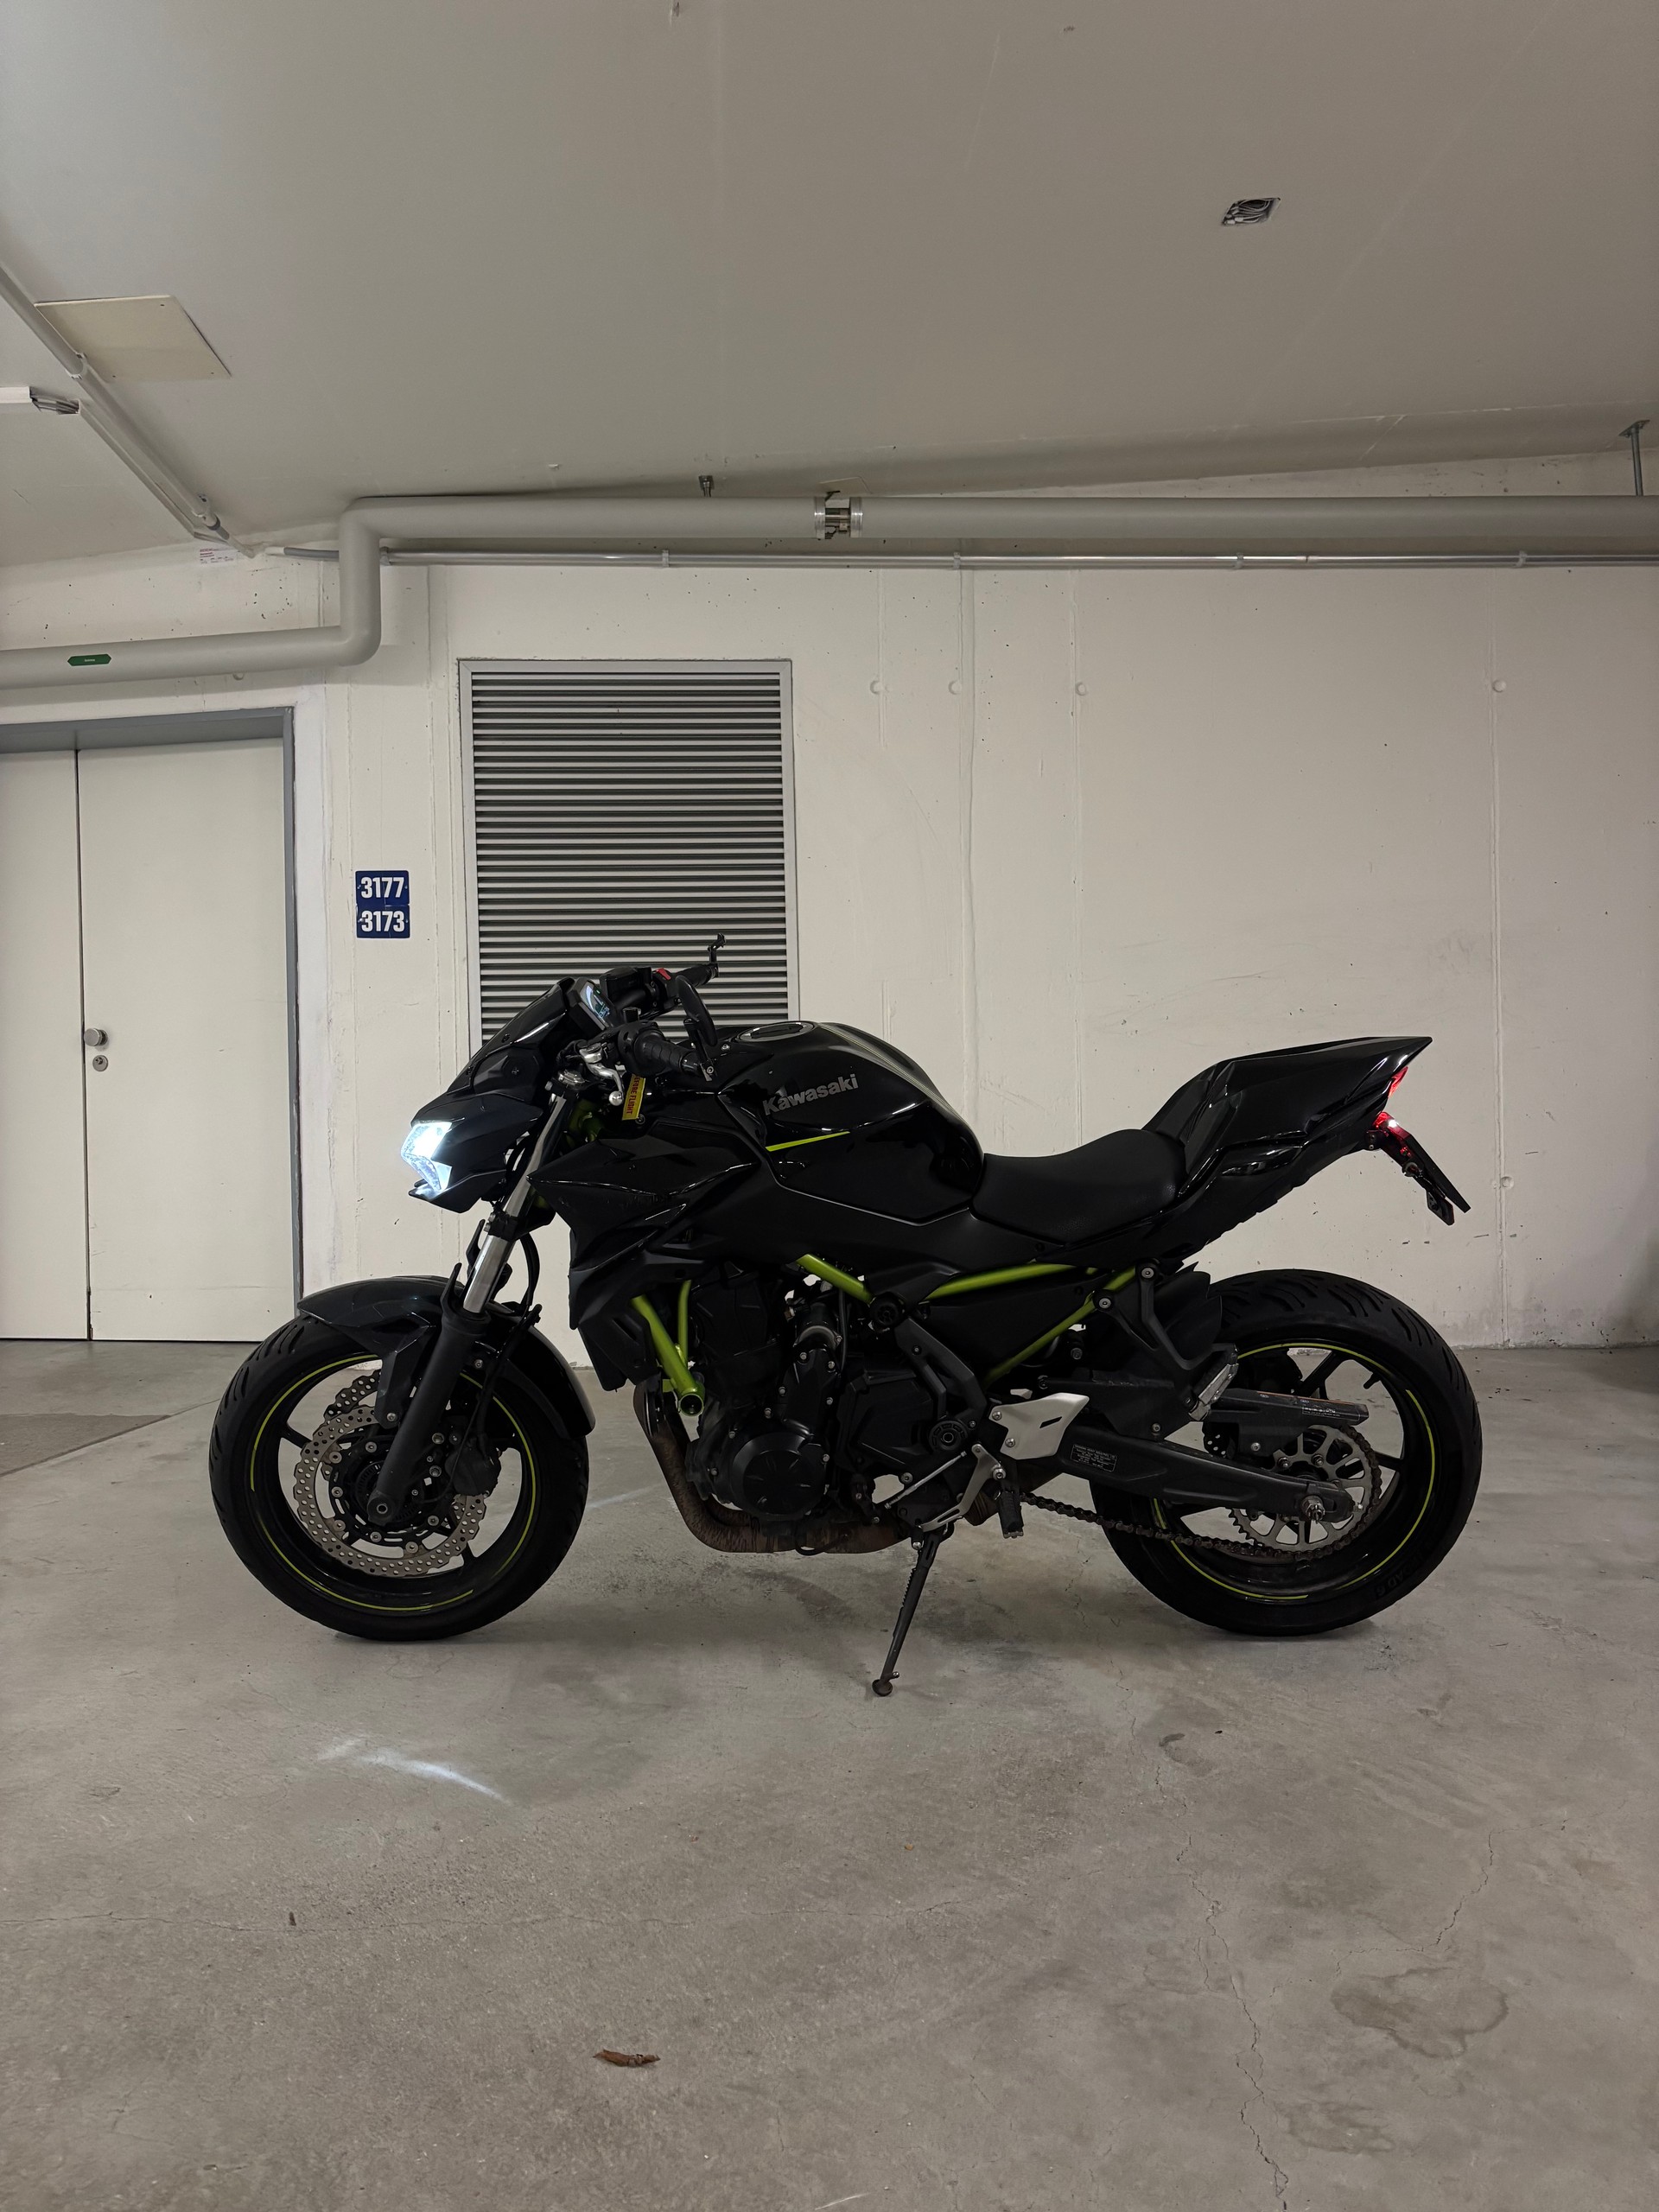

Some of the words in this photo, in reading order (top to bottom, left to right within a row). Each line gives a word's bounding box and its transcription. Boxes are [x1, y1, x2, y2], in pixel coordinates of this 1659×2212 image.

[360, 876, 404, 899] 3177
[361, 910, 405, 932] 3173
[630, 1076, 640, 1095] EFORE
[762, 1073, 859, 1116] Kawasaki
[626, 1095, 637, 1115] FLIGHT
